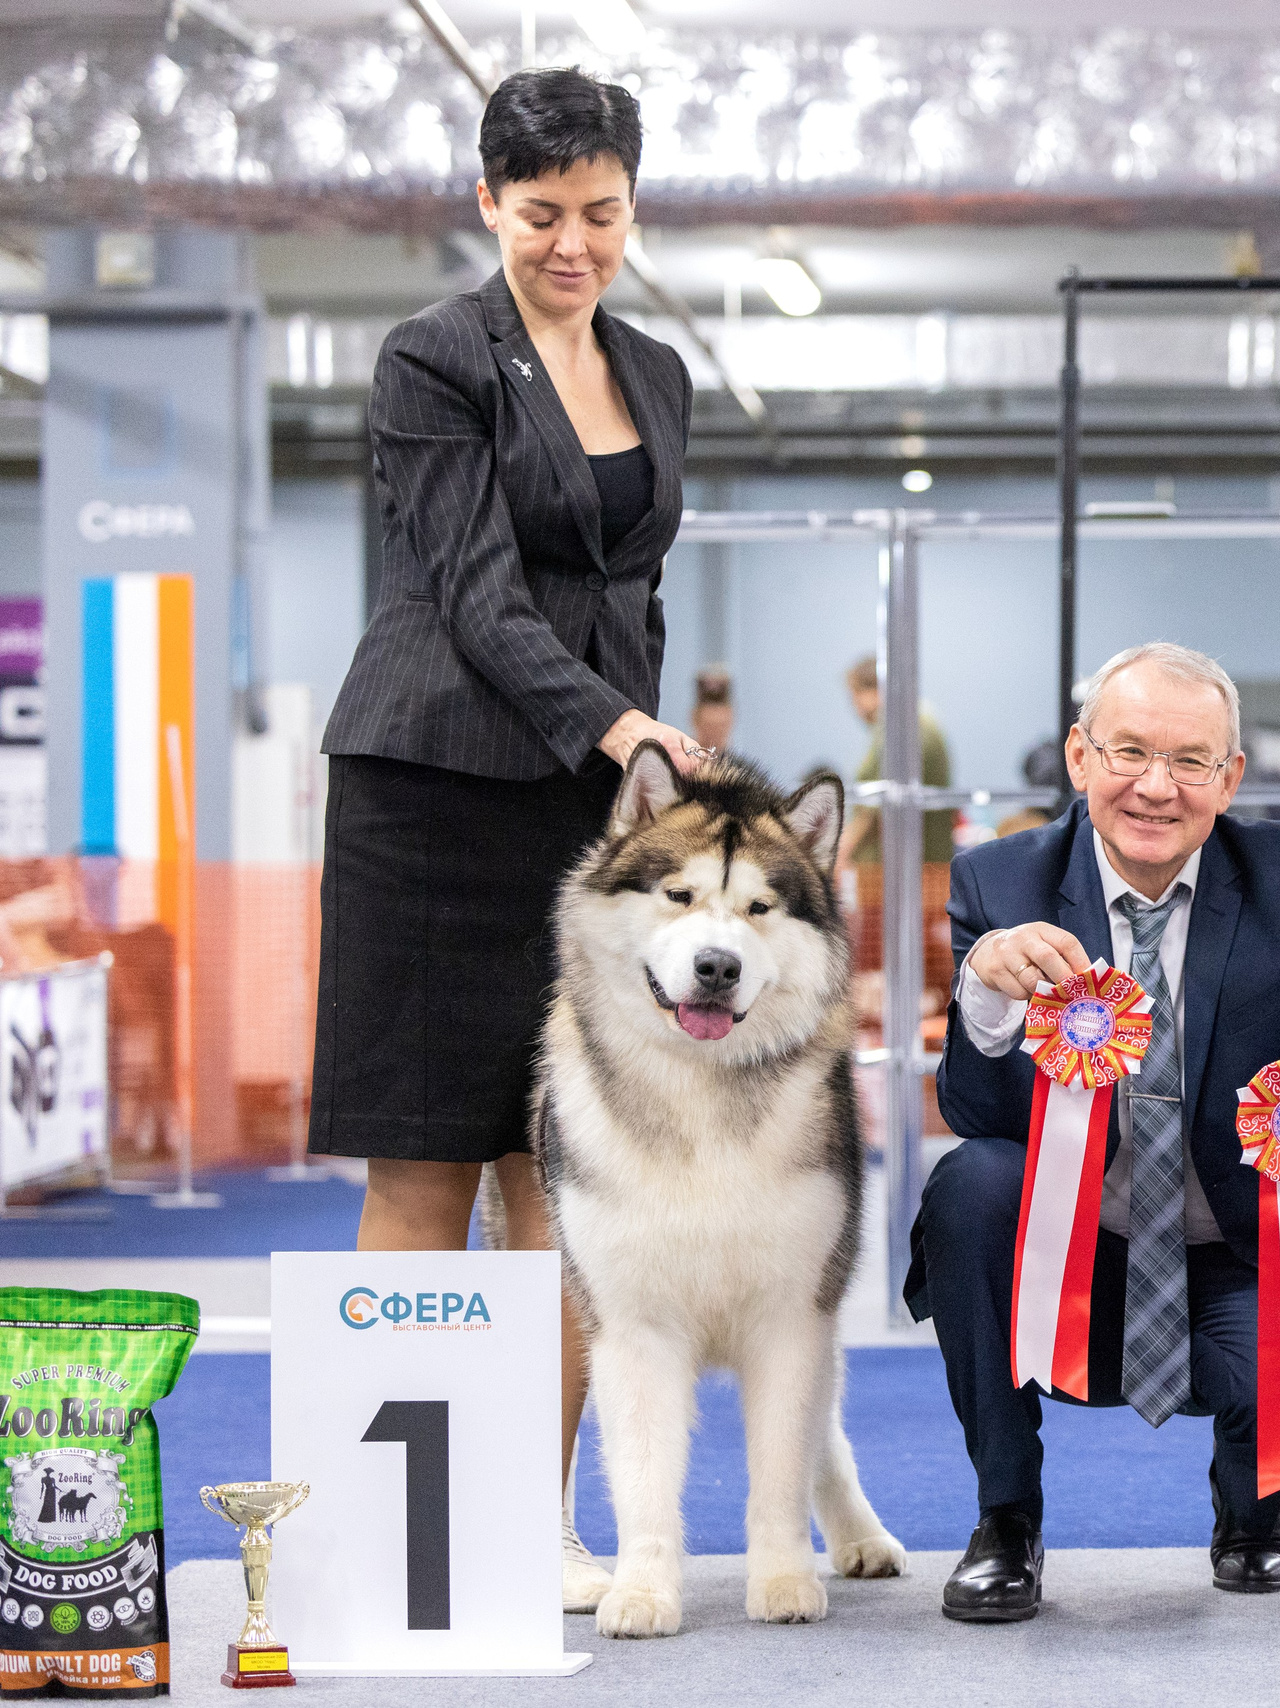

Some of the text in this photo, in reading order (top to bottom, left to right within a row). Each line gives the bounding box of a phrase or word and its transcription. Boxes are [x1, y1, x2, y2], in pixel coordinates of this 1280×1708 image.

[339, 1286, 491, 1330] СФЕРА
[393, 1323, 492, 1332] ВЫСТАВОЧНЫЙ ЦЕНТР
[11, 1364, 132, 1393] SUPER PREMIUM
[58, 1472, 93, 1485] ZooRing
[360, 1400, 451, 1630] 1
[14, 1564, 118, 1591] DOG FOOD
[36, 1655, 83, 1673] ADULT
[90, 1653, 121, 1673] DOG
[46, 1670, 121, 1685] Индейка и рис
